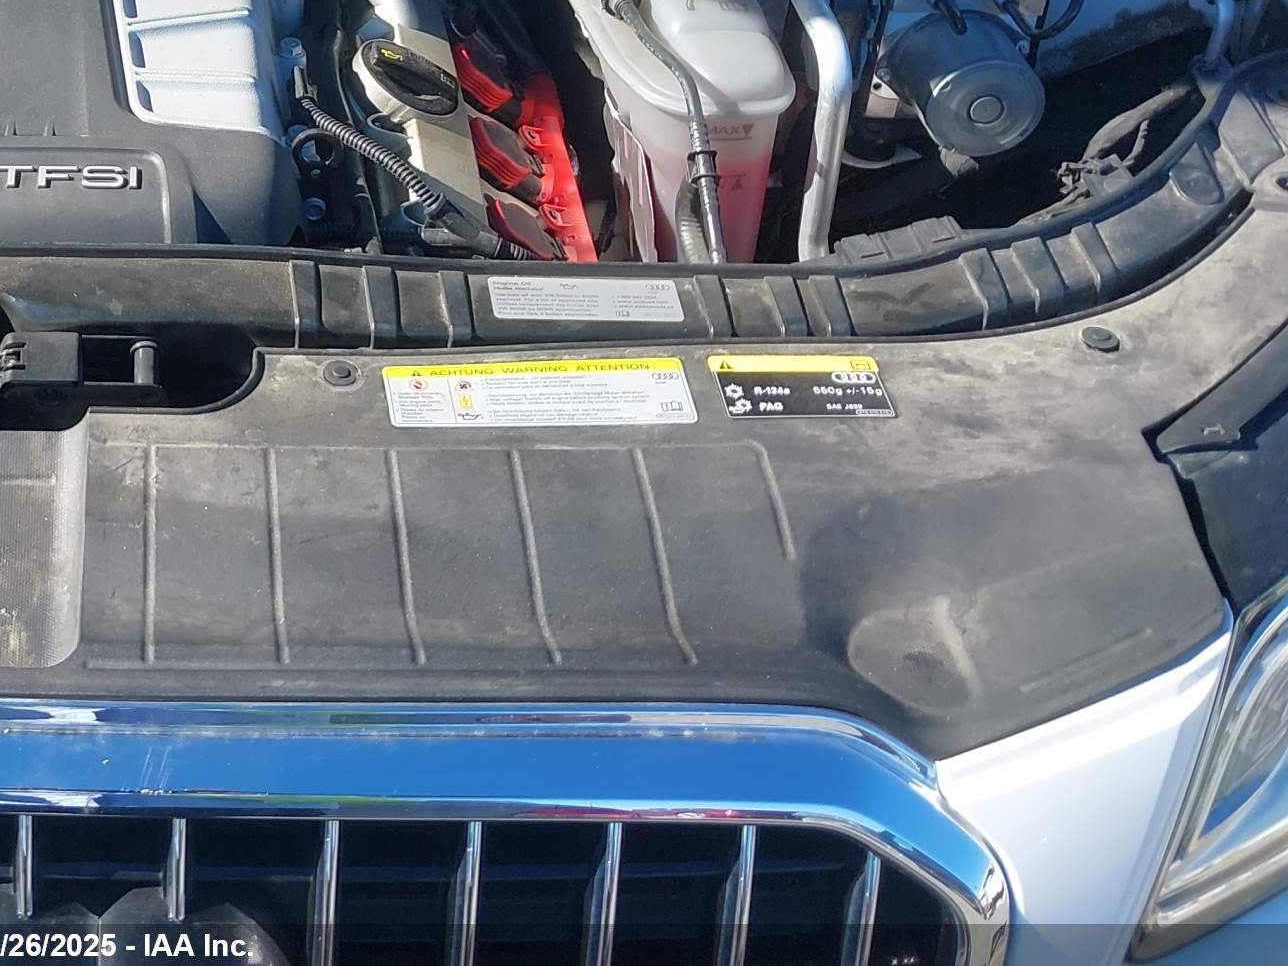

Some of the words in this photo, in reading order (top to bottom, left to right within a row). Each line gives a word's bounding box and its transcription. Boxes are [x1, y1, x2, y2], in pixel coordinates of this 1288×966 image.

[429, 366, 494, 377] ACHTUNG
[501, 364, 568, 374] WARNING
[576, 362, 651, 372] ATTENTION
[759, 401, 784, 411] PAG
